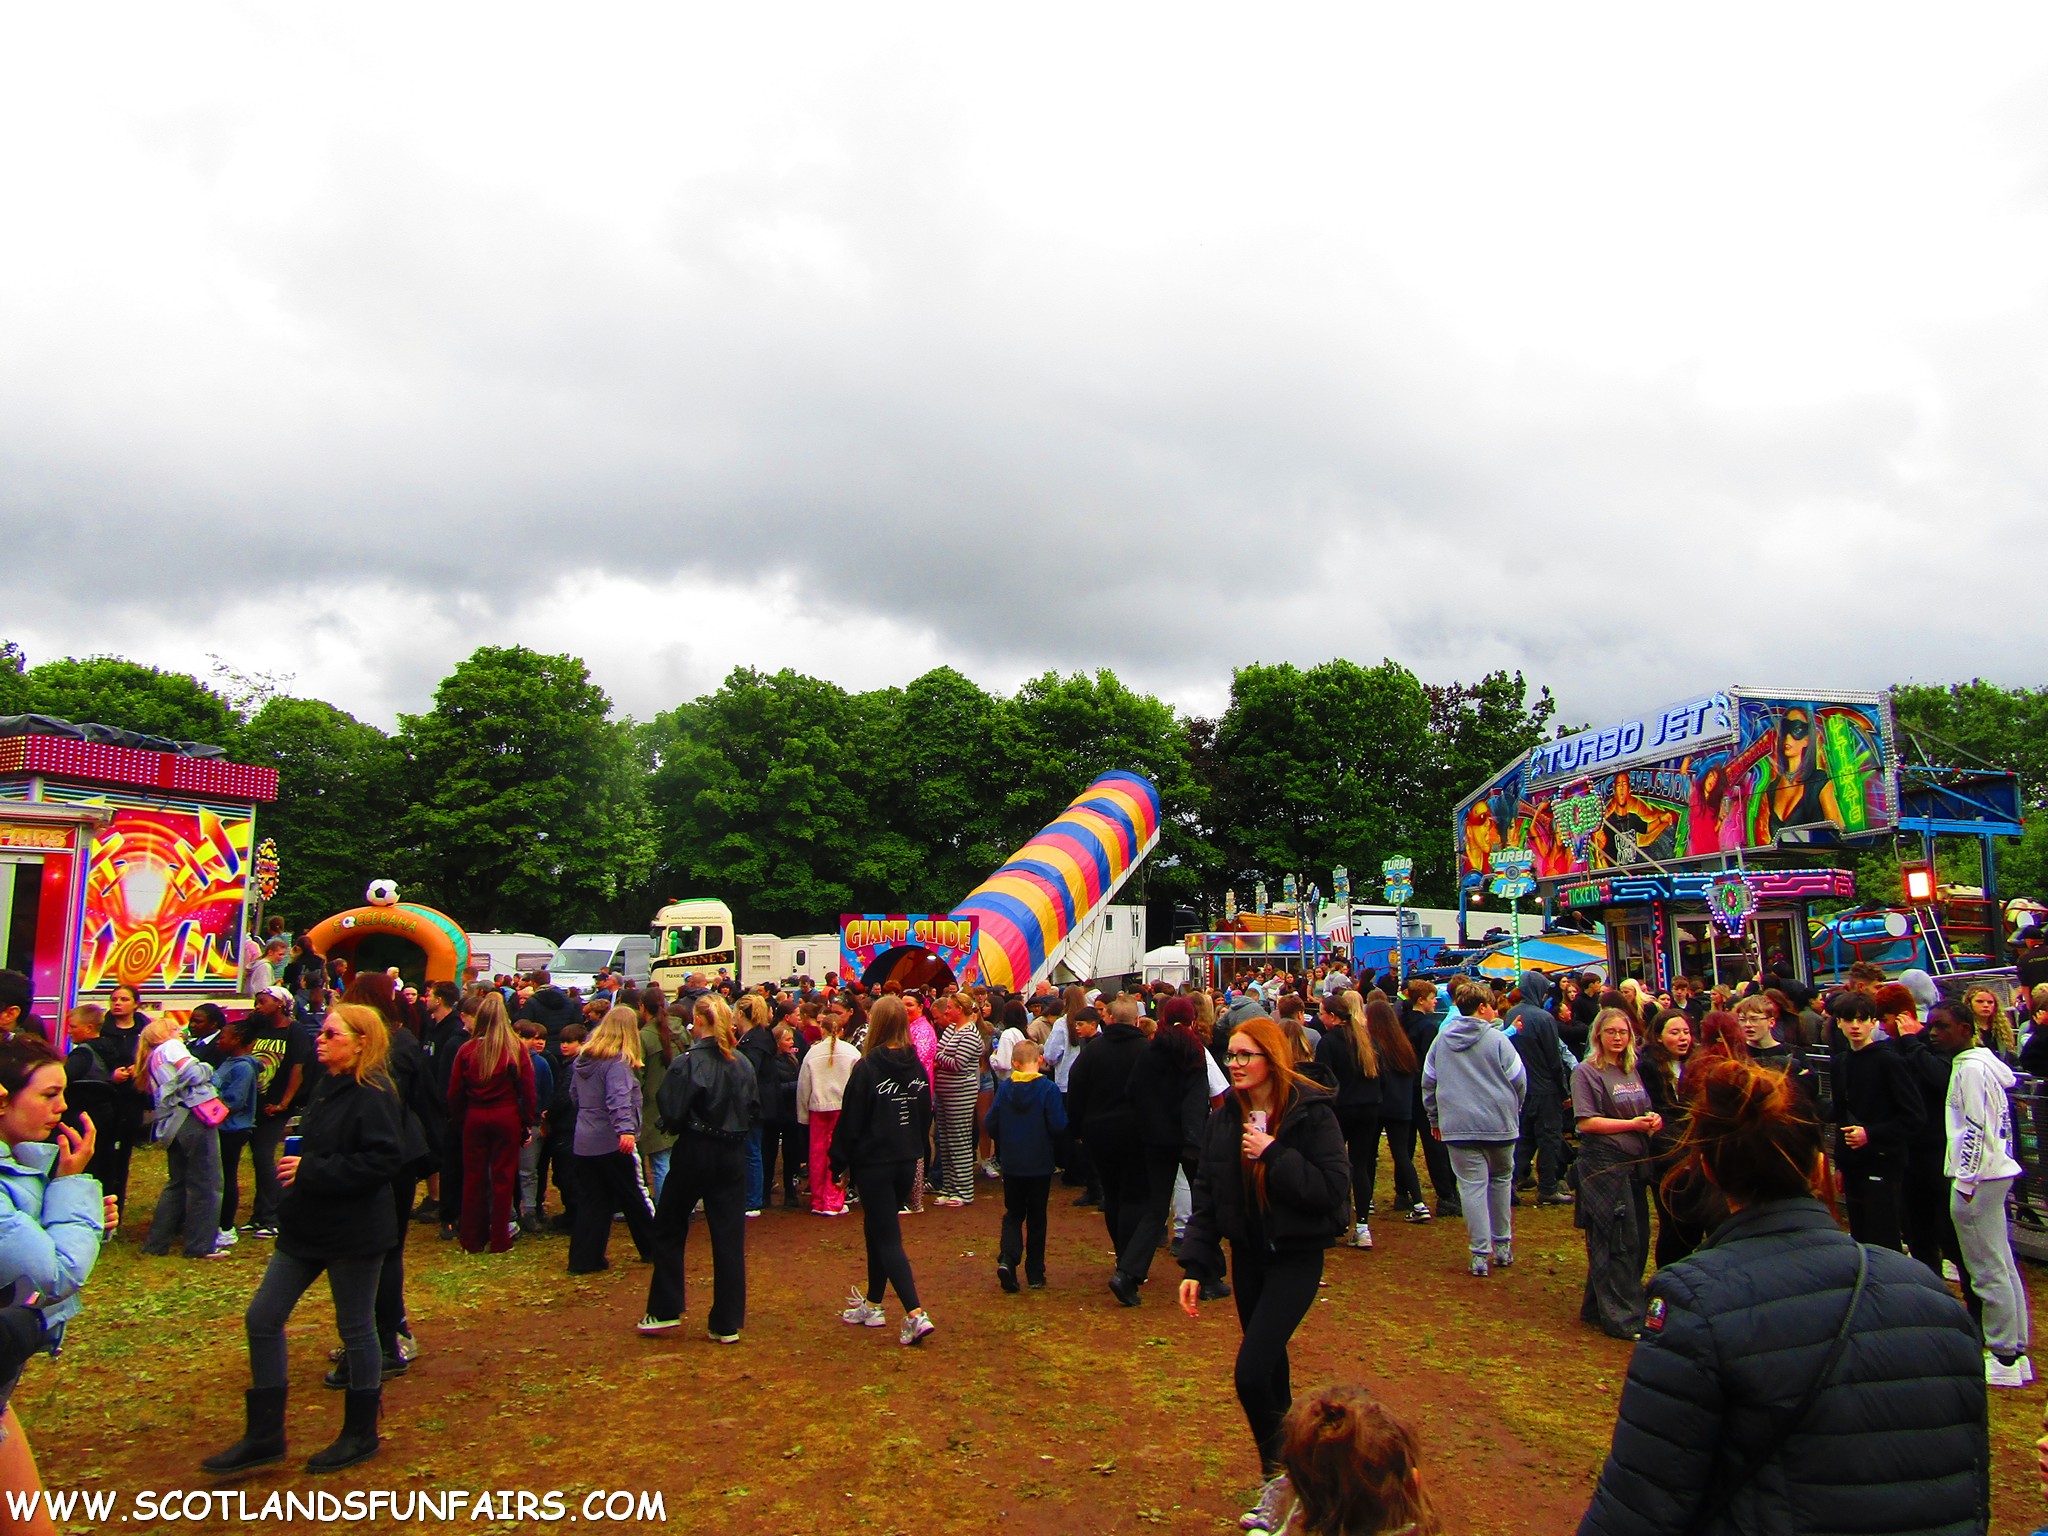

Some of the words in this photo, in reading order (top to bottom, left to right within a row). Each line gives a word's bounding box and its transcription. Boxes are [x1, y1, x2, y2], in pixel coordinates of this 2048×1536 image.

[1544, 721, 1644, 774] TURBO
[1650, 700, 1712, 746] JET
[1829, 714, 1862, 823] ULTIMATE
[1382, 857, 1412, 871] TURBO
[1489, 850, 1533, 863] TURBO
[1389, 889, 1408, 904] JET
[1498, 882, 1528, 898] JET
[1567, 885, 1600, 906] TICKETS
[844, 919, 910, 951] GIANT
[913, 919, 972, 954] SLIDE
[668, 952, 727, 966] HORNE'S
